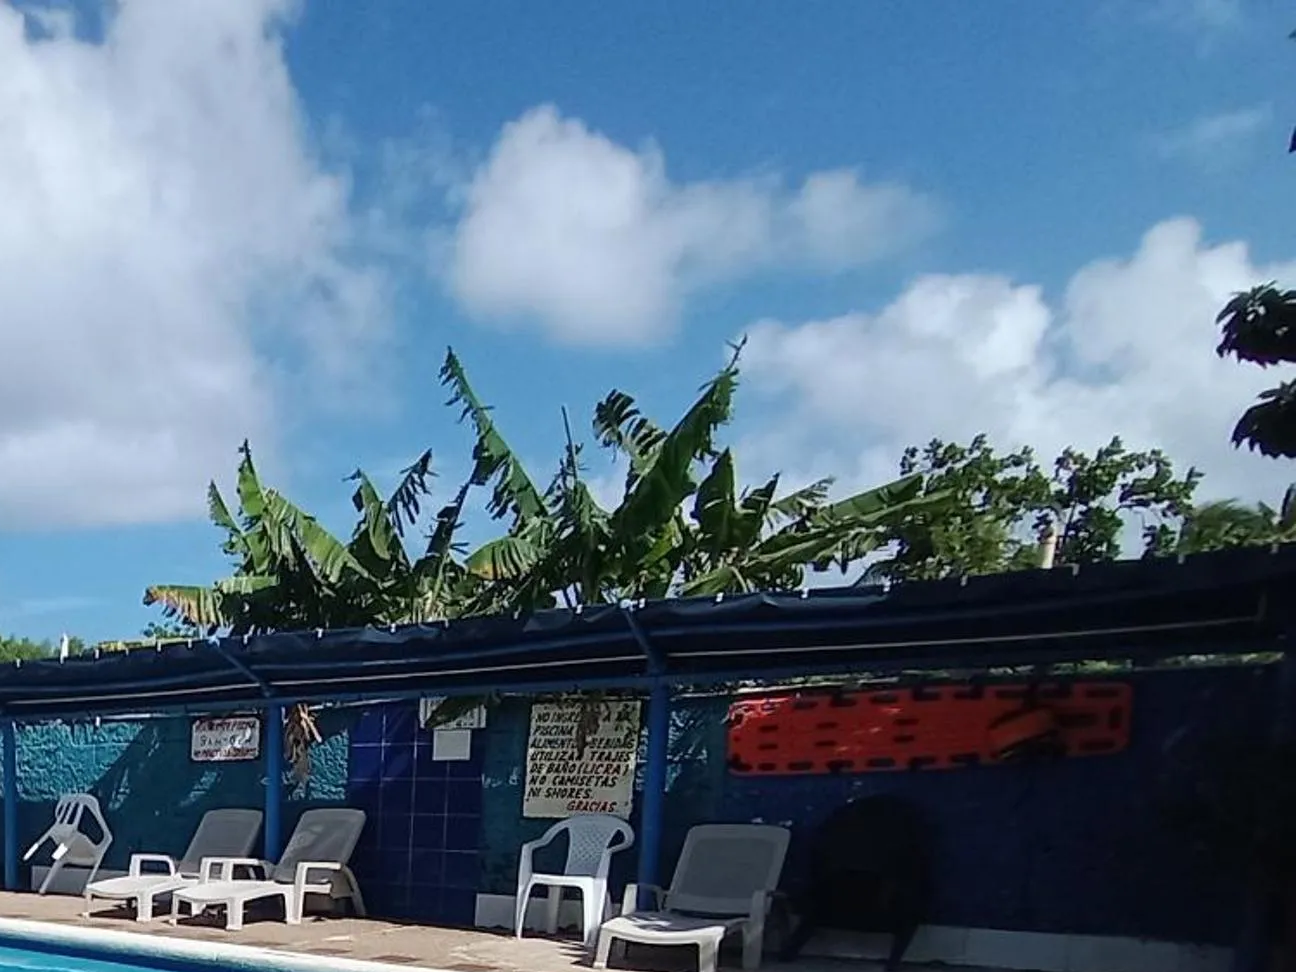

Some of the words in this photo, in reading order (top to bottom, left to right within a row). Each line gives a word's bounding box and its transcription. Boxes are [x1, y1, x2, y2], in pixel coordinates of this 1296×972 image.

[536, 711, 550, 723] NO
[533, 725, 575, 736] PISCINA
[590, 751, 632, 762] TRAJES
[529, 763, 545, 774] DE
[547, 762, 576, 774] BAÑO
[577, 762, 630, 776] (LICRA)
[529, 776, 547, 786] NO
[552, 776, 619, 787] CAMISETAS
[528, 787, 541, 798] NI
